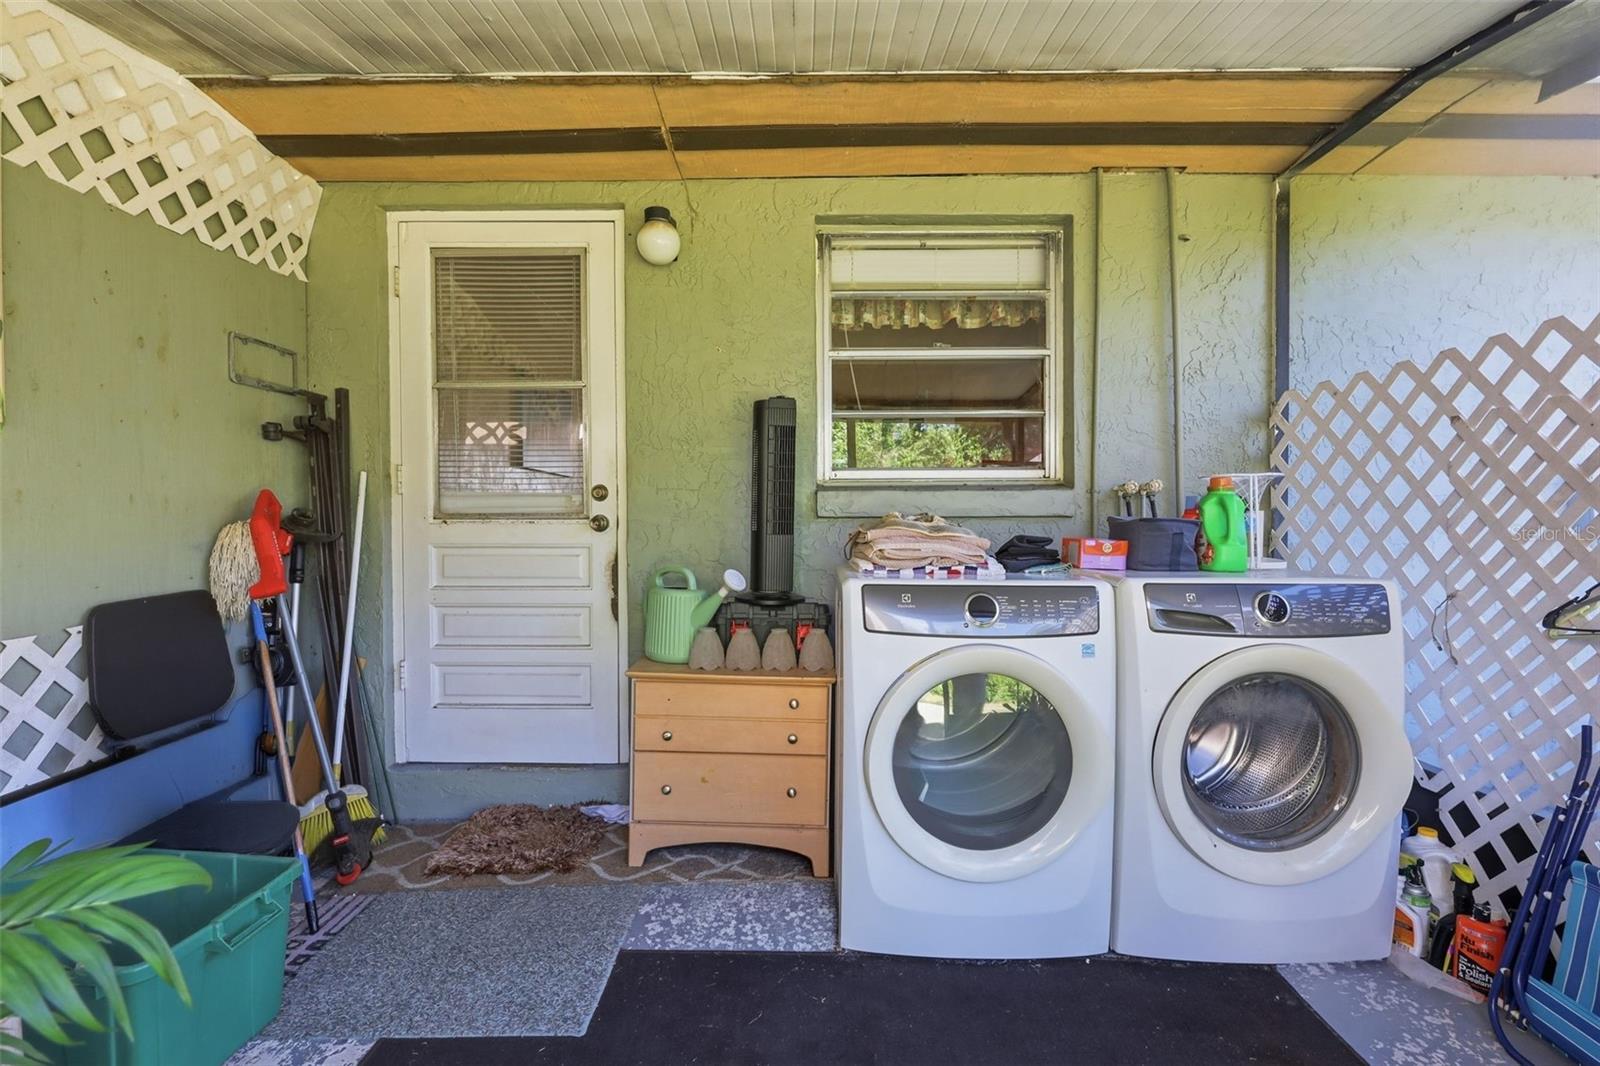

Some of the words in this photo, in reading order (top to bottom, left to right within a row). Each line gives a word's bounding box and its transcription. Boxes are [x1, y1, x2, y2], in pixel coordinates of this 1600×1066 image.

[1461, 934, 1475, 945] Nu
[1460, 942, 1495, 961] Finish
[1459, 963, 1493, 983] Polish
